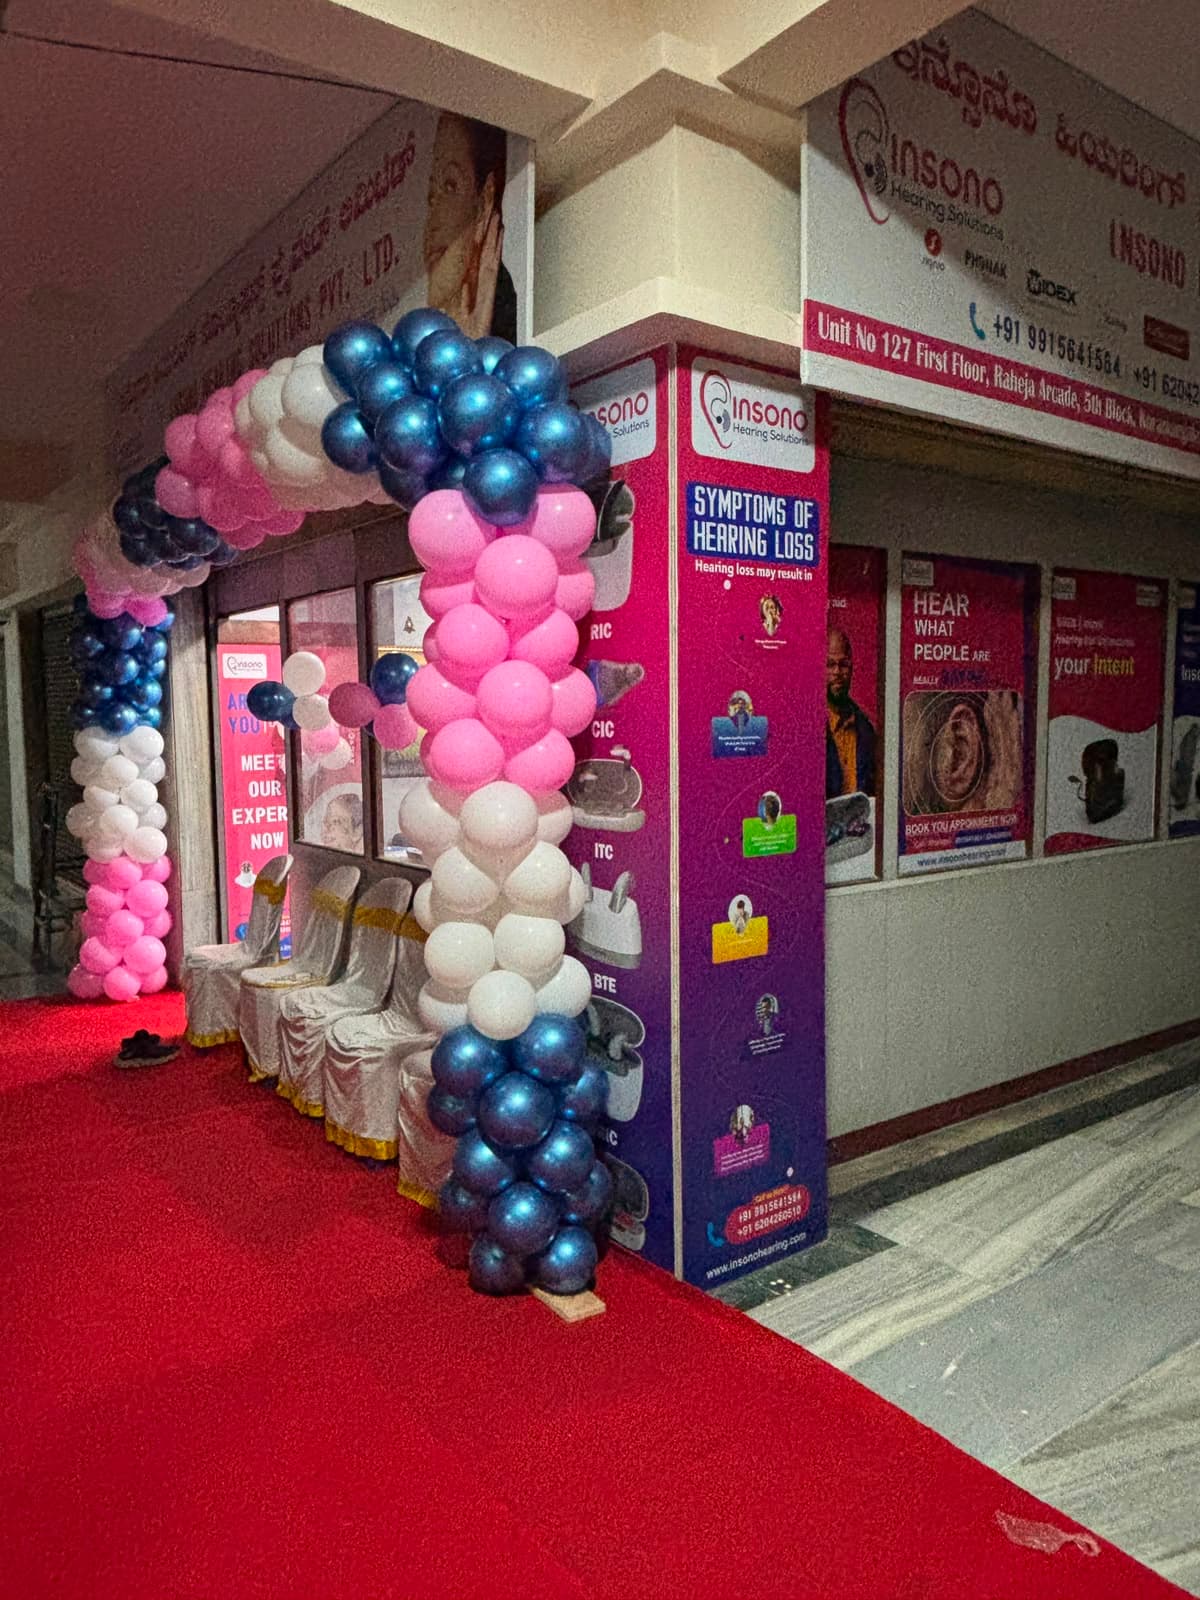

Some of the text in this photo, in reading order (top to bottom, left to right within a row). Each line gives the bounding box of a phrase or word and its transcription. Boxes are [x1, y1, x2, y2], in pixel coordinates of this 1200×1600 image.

[891, 182, 1004, 241] Hearing Solutions
[362, 232, 400, 287] LTD.
[1110, 219, 1186, 288] INSONO
[993, 314, 1020, 345] +91
[1133, 367, 1157, 393] +91
[818, 311, 851, 347] Unit
[856, 326, 876, 353] No
[882, 330, 910, 363] 127
[916, 341, 949, 376] First
[952, 352, 990, 389] Floor,
[994, 364, 1035, 402] Raheja
[1039, 378, 1081, 414] Arcade,
[1084, 391, 1103, 417] 5th
[588, 391, 649, 427] sono
[612, 420, 650, 438] Solutions
[733, 422, 809, 446] Hearing Solutions
[694, 485, 814, 529] SYMPTOMS OF
[694, 521, 814, 562] HEARING LOSS
[695, 559, 813, 581] Hearing loss may result in
[914, 591, 969, 617] HEAR
[590, 622, 612, 640] RIC
[914, 619, 955, 637] WHAT
[914, 643, 991, 662] PEOPLE ARE
[1054, 657, 1090, 680] your
[228, 692, 248, 711] AR
[228, 716, 260, 734] YOU
[591, 721, 614, 738] CIC
[248, 780, 282, 798] OUR
[231, 805, 288, 825] EXPER
[905, 823, 931, 836] BOOK
[250, 831, 284, 850] NOW
[594, 842, 614, 861] ITC
[594, 974, 617, 993] BTE
[737, 1224, 752, 1237] +91
[706, 1231, 807, 1279] www.insonohearing.com
